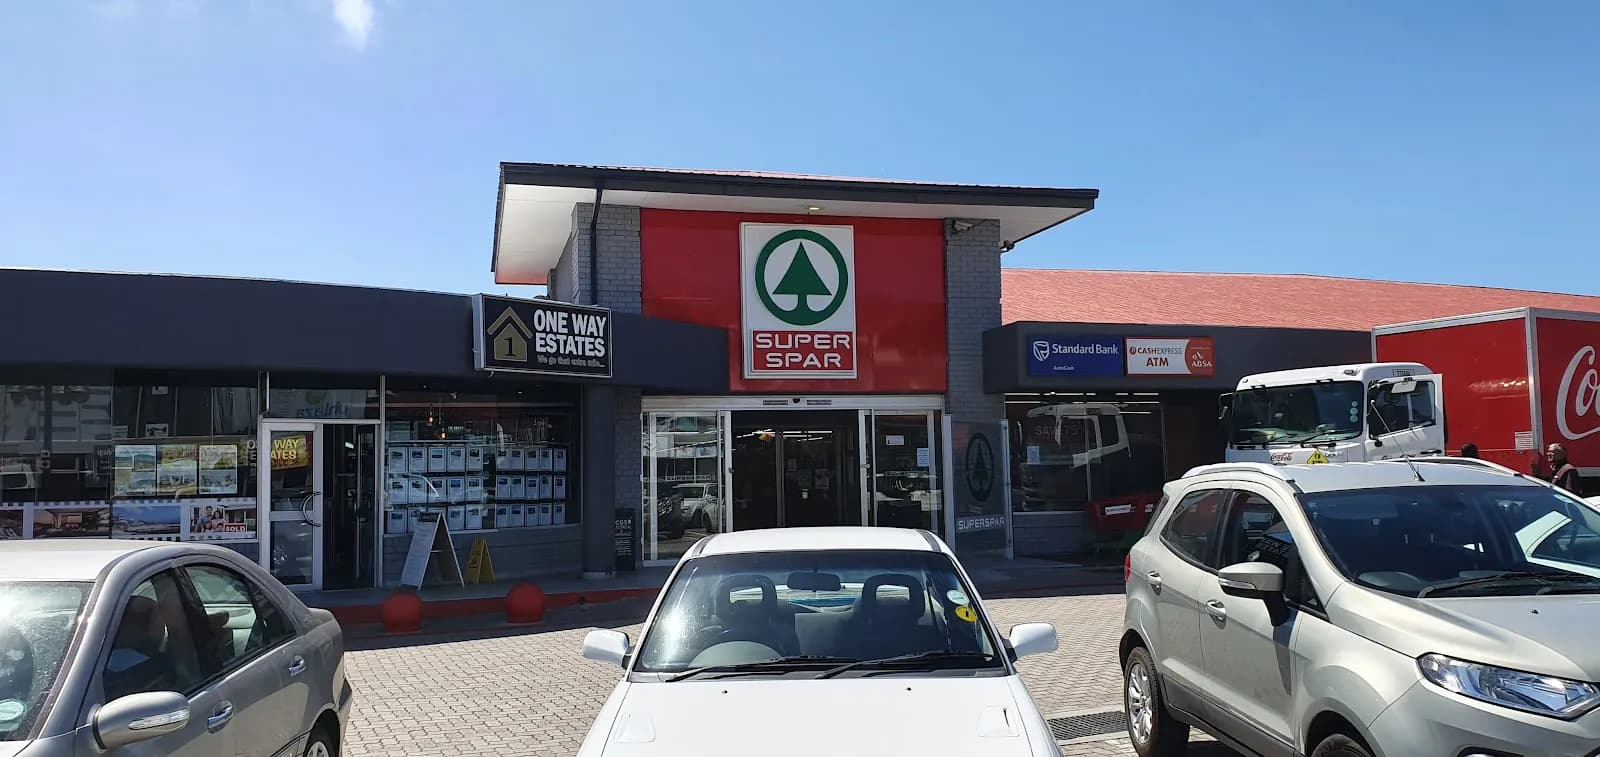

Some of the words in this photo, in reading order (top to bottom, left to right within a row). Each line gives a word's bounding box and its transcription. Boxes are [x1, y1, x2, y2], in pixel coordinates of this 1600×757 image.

[534, 309, 568, 333] ONE
[571, 313, 607, 337] WAY
[503, 336, 516, 357] 1
[535, 332, 606, 358] ESTATES
[755, 333, 851, 350] SUPER
[1052, 343, 1094, 354] Standard
[1095, 344, 1119, 355] Bank
[765, 352, 842, 369] SPAR
[1146, 357, 1169, 367] ATM
[1191, 360, 1213, 368] ABSA
[1556, 345, 1600, 440] Co
[273, 439, 300, 449] WAY
[225, 525, 246, 533] SOLD
[958, 516, 1005, 530] SUPERSPAR
